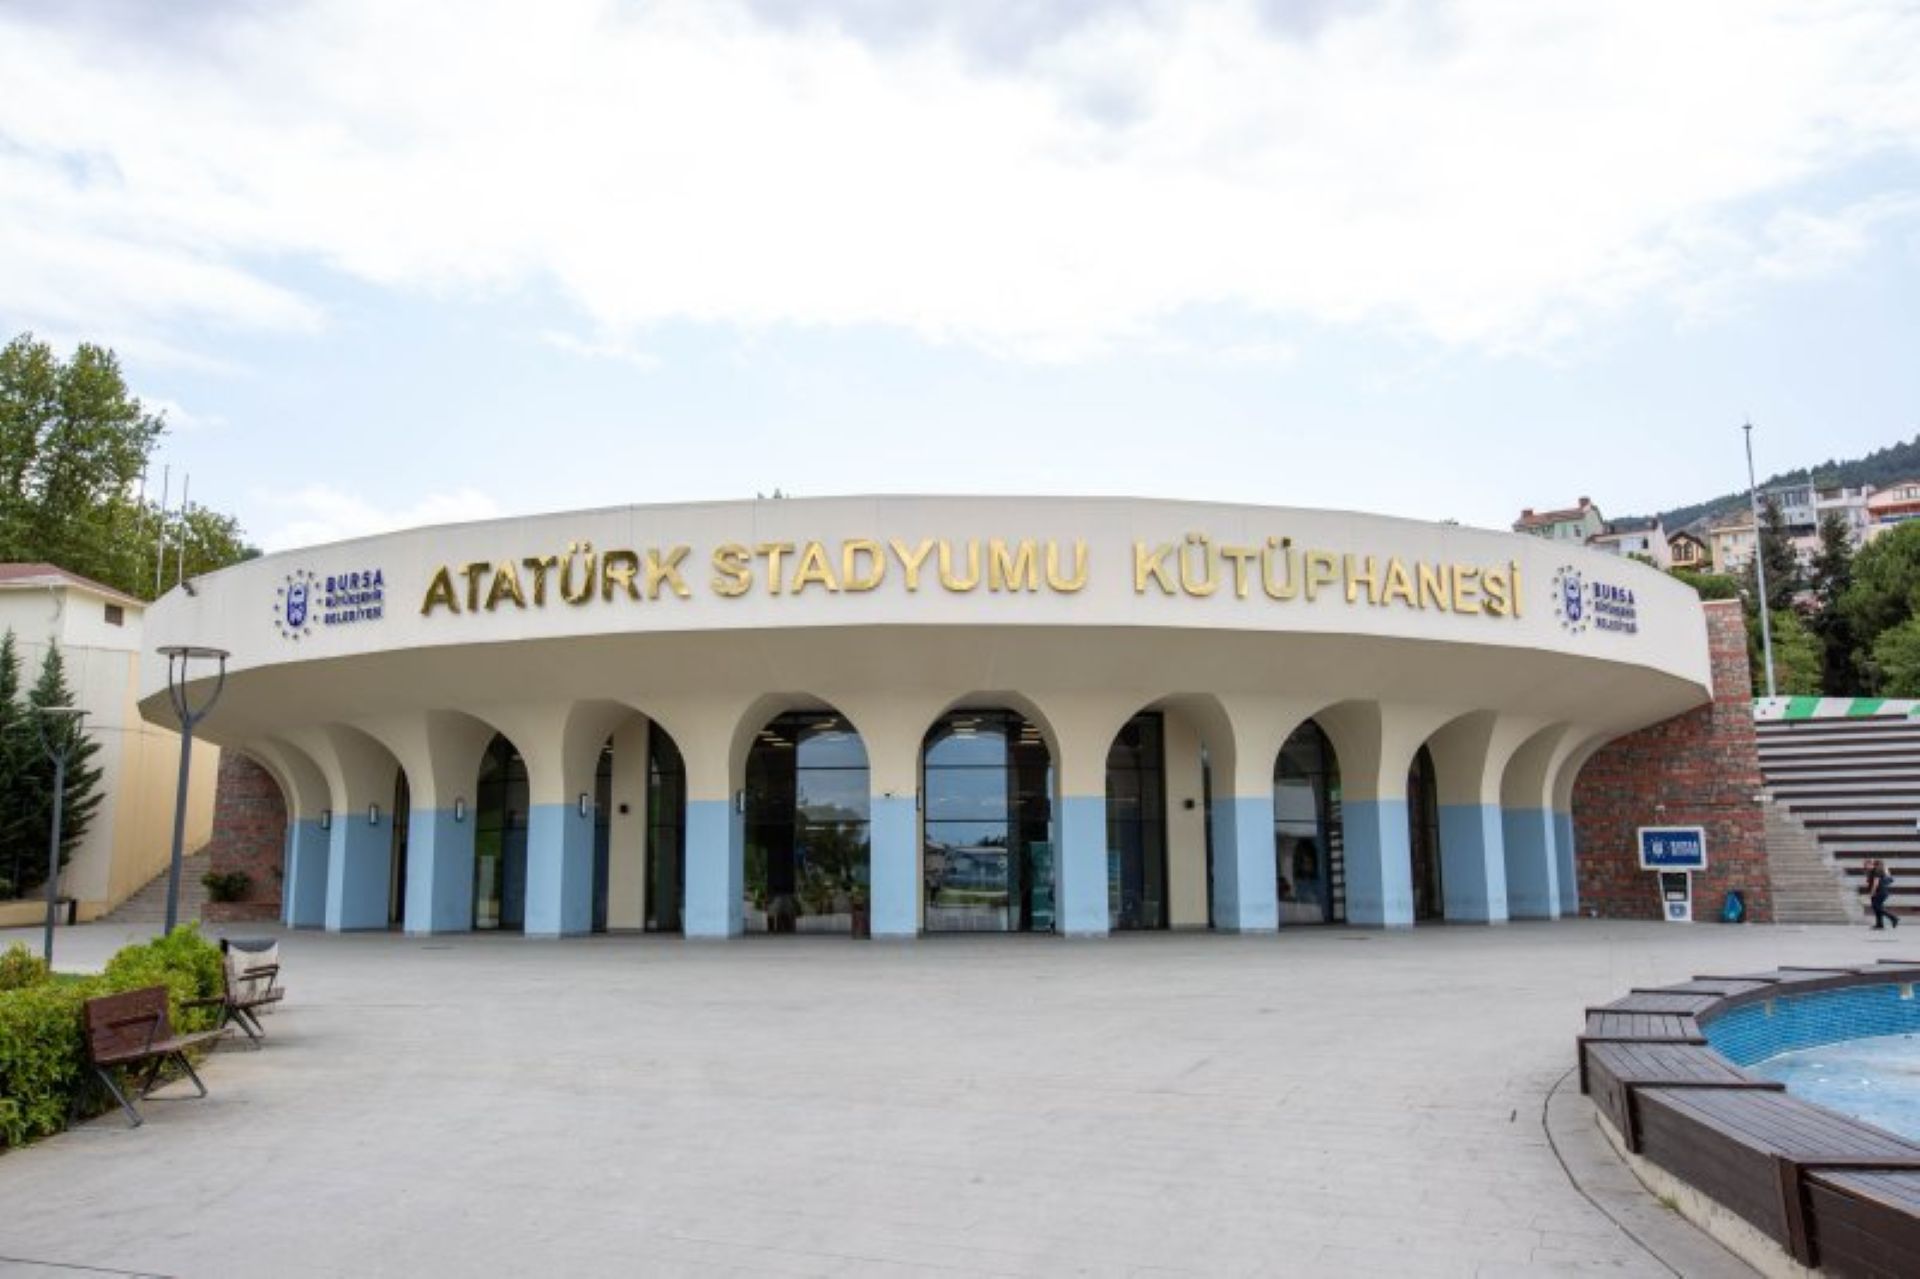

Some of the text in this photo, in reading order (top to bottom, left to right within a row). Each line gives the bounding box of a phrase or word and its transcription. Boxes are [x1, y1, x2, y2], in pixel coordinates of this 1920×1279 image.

[325, 568, 383, 593] BURSA
[421, 533, 1523, 619] ATATÜRK STADYUMU KÜTÜPHANESİ
[1592, 581, 1635, 605] BURSA
